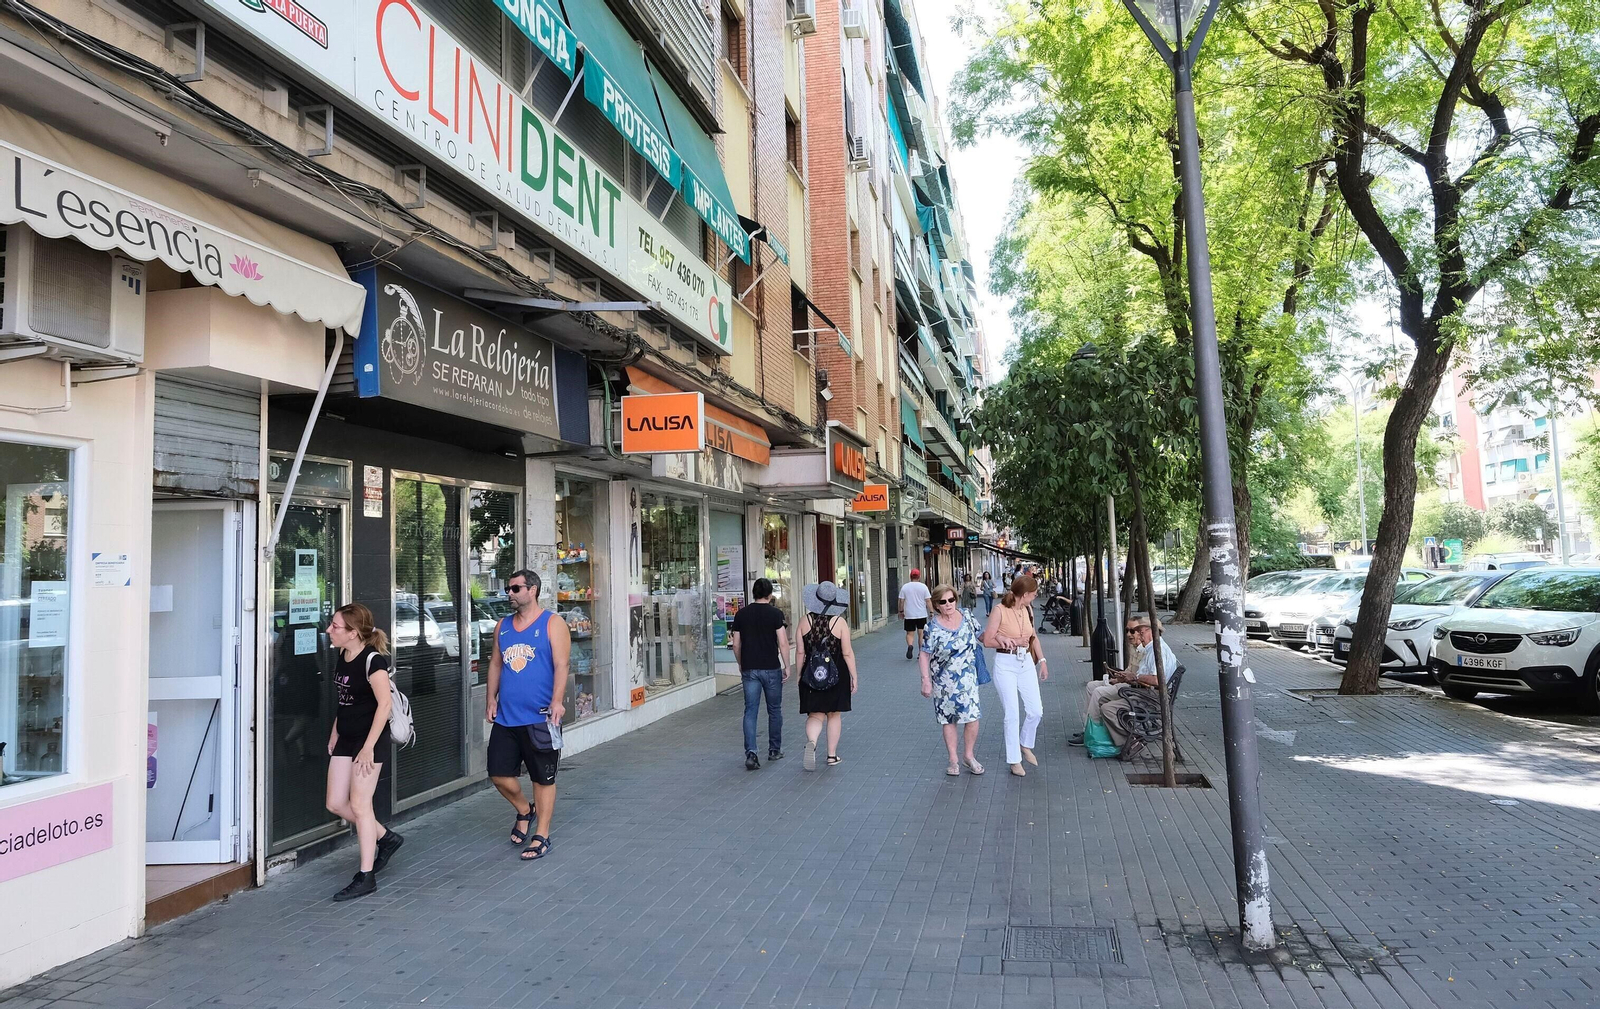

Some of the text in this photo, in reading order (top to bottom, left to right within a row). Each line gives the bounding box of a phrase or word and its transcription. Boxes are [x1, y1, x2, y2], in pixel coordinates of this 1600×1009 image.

[289, 5, 325, 43] PUERTA
[376, 0, 622, 249] CLINIDENT
[603, 76, 670, 178] PROTESIS
[374, 89, 458, 159] CENTRO
[467, 153, 486, 181] DE
[495, 173, 542, 217] SALUD
[693, 179, 745, 256] IMPLANTES
[638, 226, 705, 297] TEL. 957 436 070
[647, 273, 663, 295] FAX:
[666, 287, 678, 304] 957
[431, 307, 550, 396] La Relojería
[432, 360, 450, 382] SE
[451, 366, 503, 399] REPARAN
[520, 386, 550, 409] todo tipo
[522, 405, 553, 427] de relojes
[627, 415, 694, 432] LALISA
[1463, 657, 1503, 668] 4396 KGF
